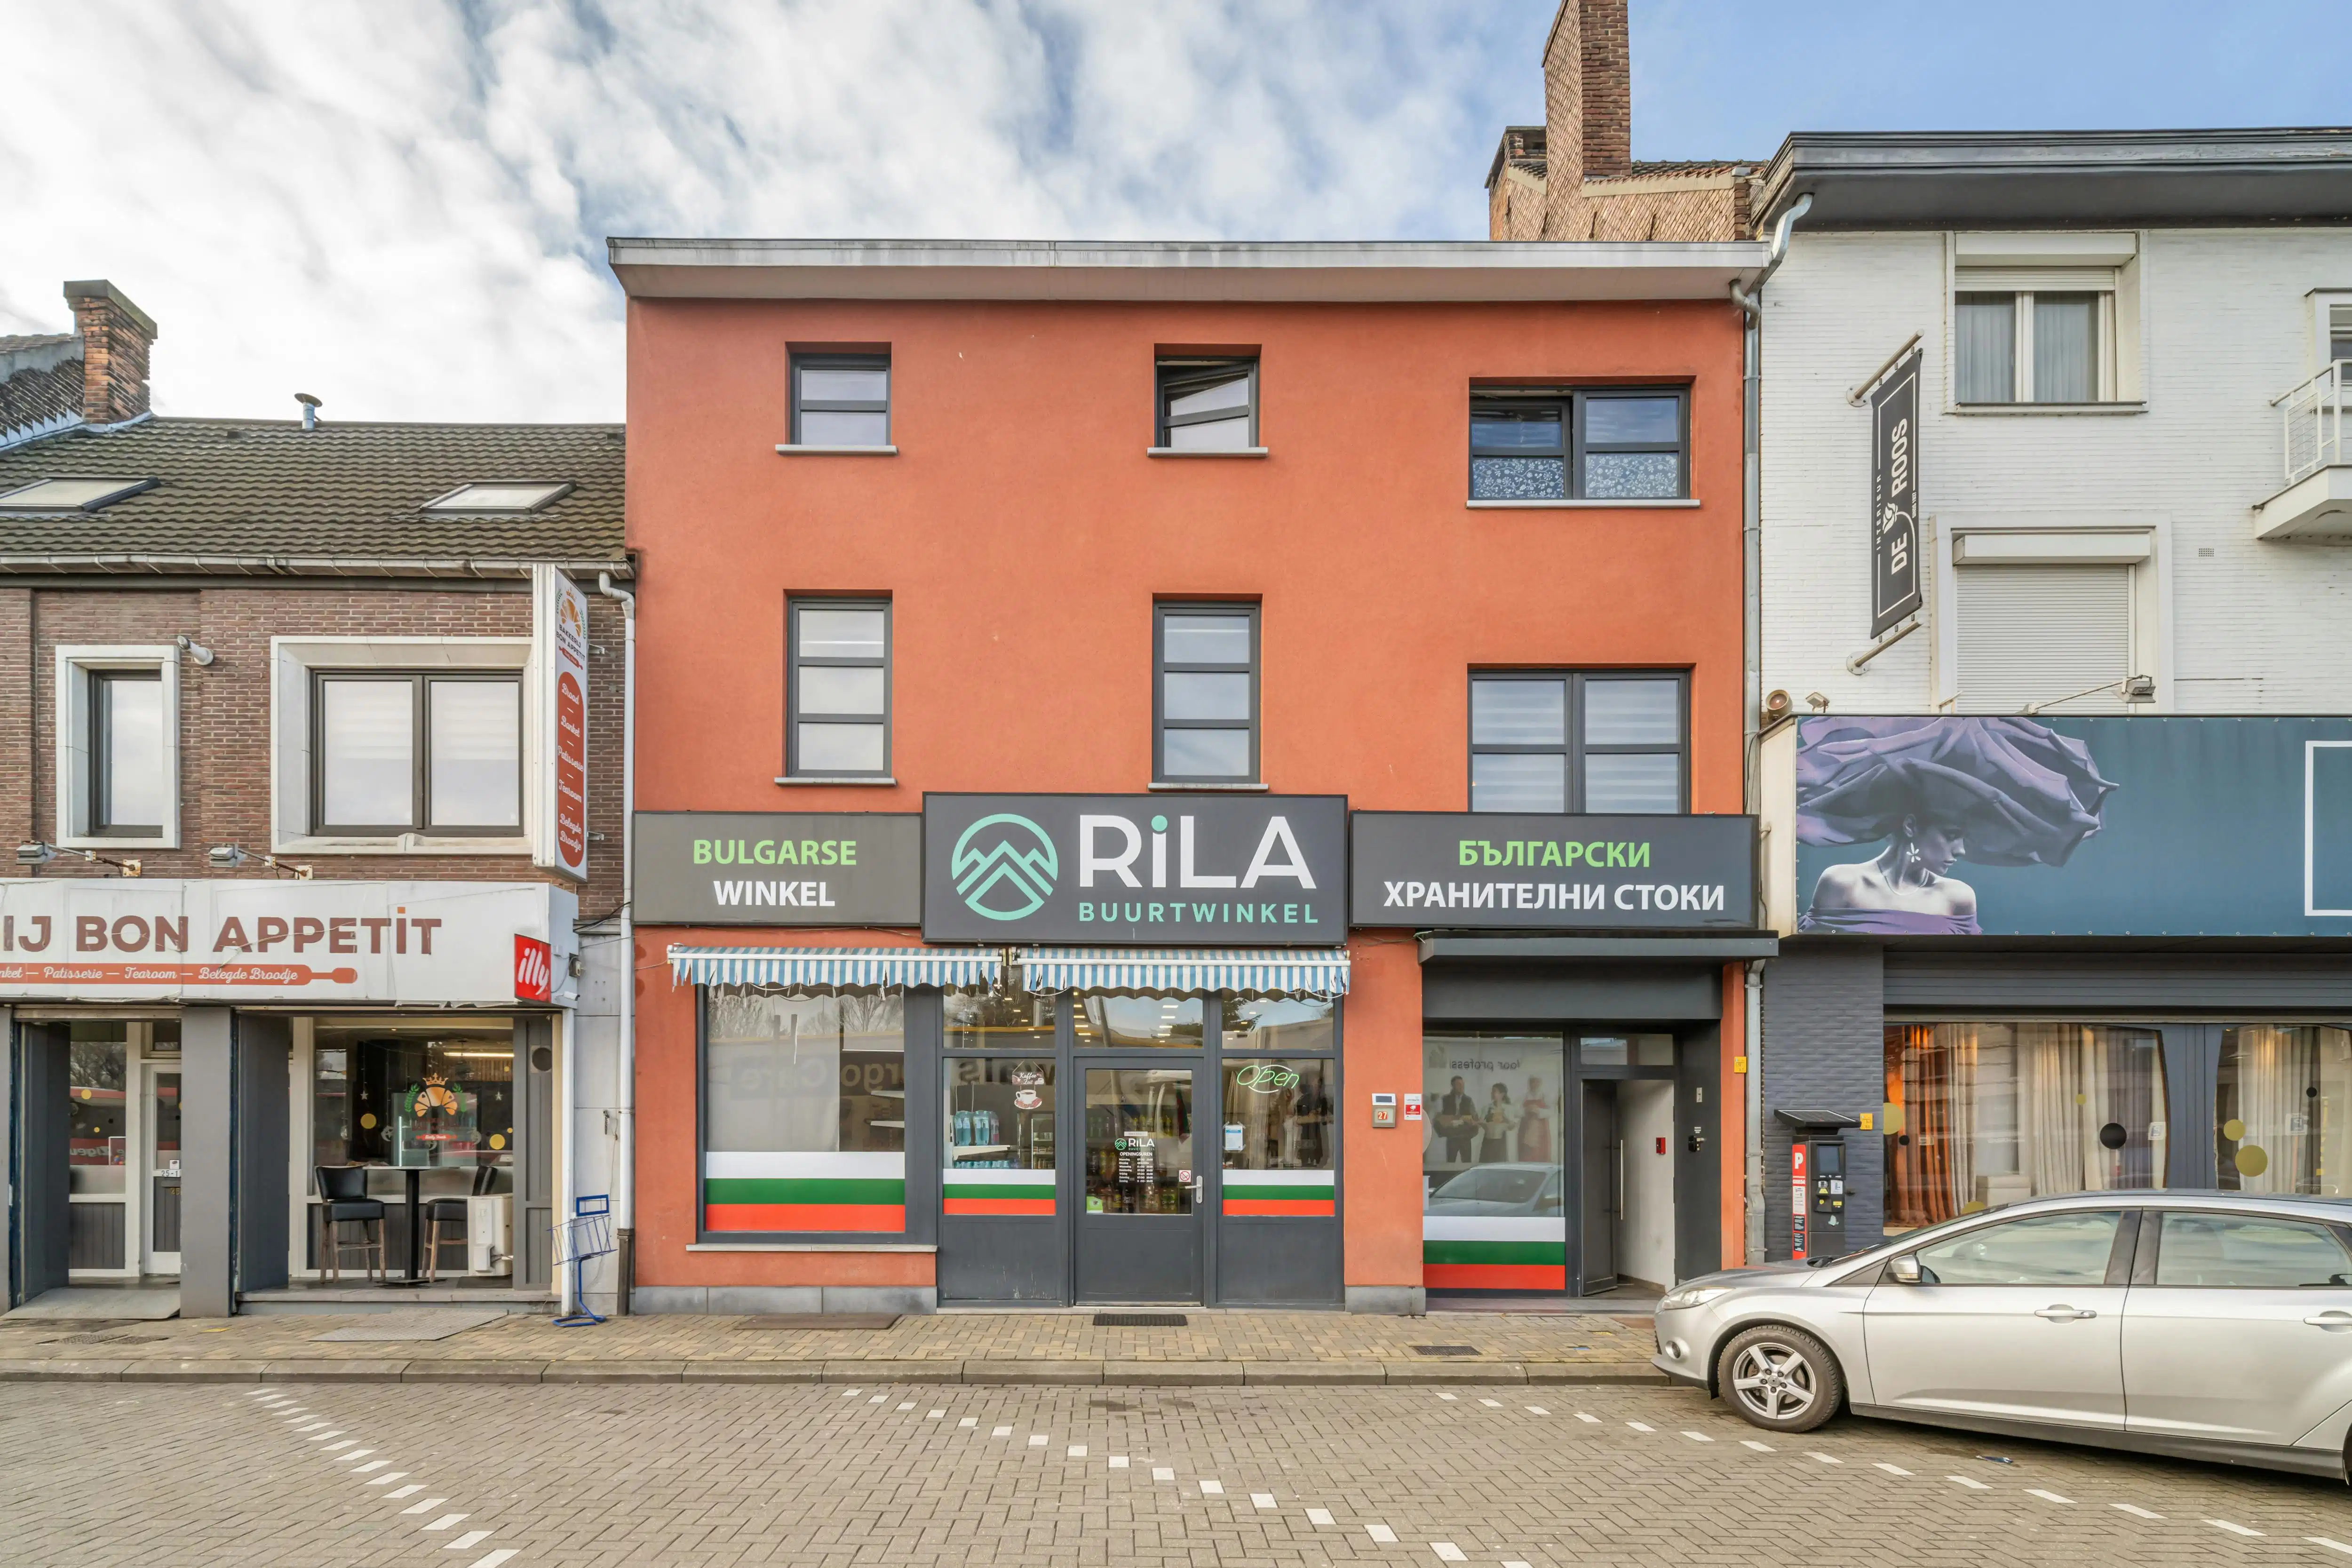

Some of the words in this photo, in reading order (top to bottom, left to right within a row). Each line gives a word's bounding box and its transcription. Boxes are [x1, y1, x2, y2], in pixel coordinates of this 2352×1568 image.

[1891, 418, 1907, 498] ROOS
[1891, 532, 1907, 575] DE
[556, 631, 566, 644] BON
[567, 642, 585, 661] APPETIT
[559, 624, 581, 648] BAKKERIJ
[562, 683, 579, 705] Brood
[561, 716, 580, 737] Banket
[557, 745, 583, 772] Patisserie
[559, 779, 582, 803] Tearoom
[560, 813, 581, 834] Belegde
[560, 830, 581, 852] Broodje
[692, 840, 856, 866] BULGARSE
[1459, 840, 1650, 868] БЪЛГАРСКИ
[713, 881, 835, 907] WINKEL
[1383, 881, 1605, 910] ХРАНИТЕЛНИ
[1613, 883, 1724, 911] СТОКИ
[1079, 902, 1318, 923] BUURTWINKEL
[76, 915, 189, 952] BON
[44, 966, 103, 979] Patisserie
[124, 966, 177, 979] Tearoom
[198, 967, 247, 984] Belegde
[249, 968, 298, 984] Broodje
[517, 947, 549, 995] illy
[1237, 1065, 1300, 1089] Open
[1795, 1152, 1804, 1169] P
